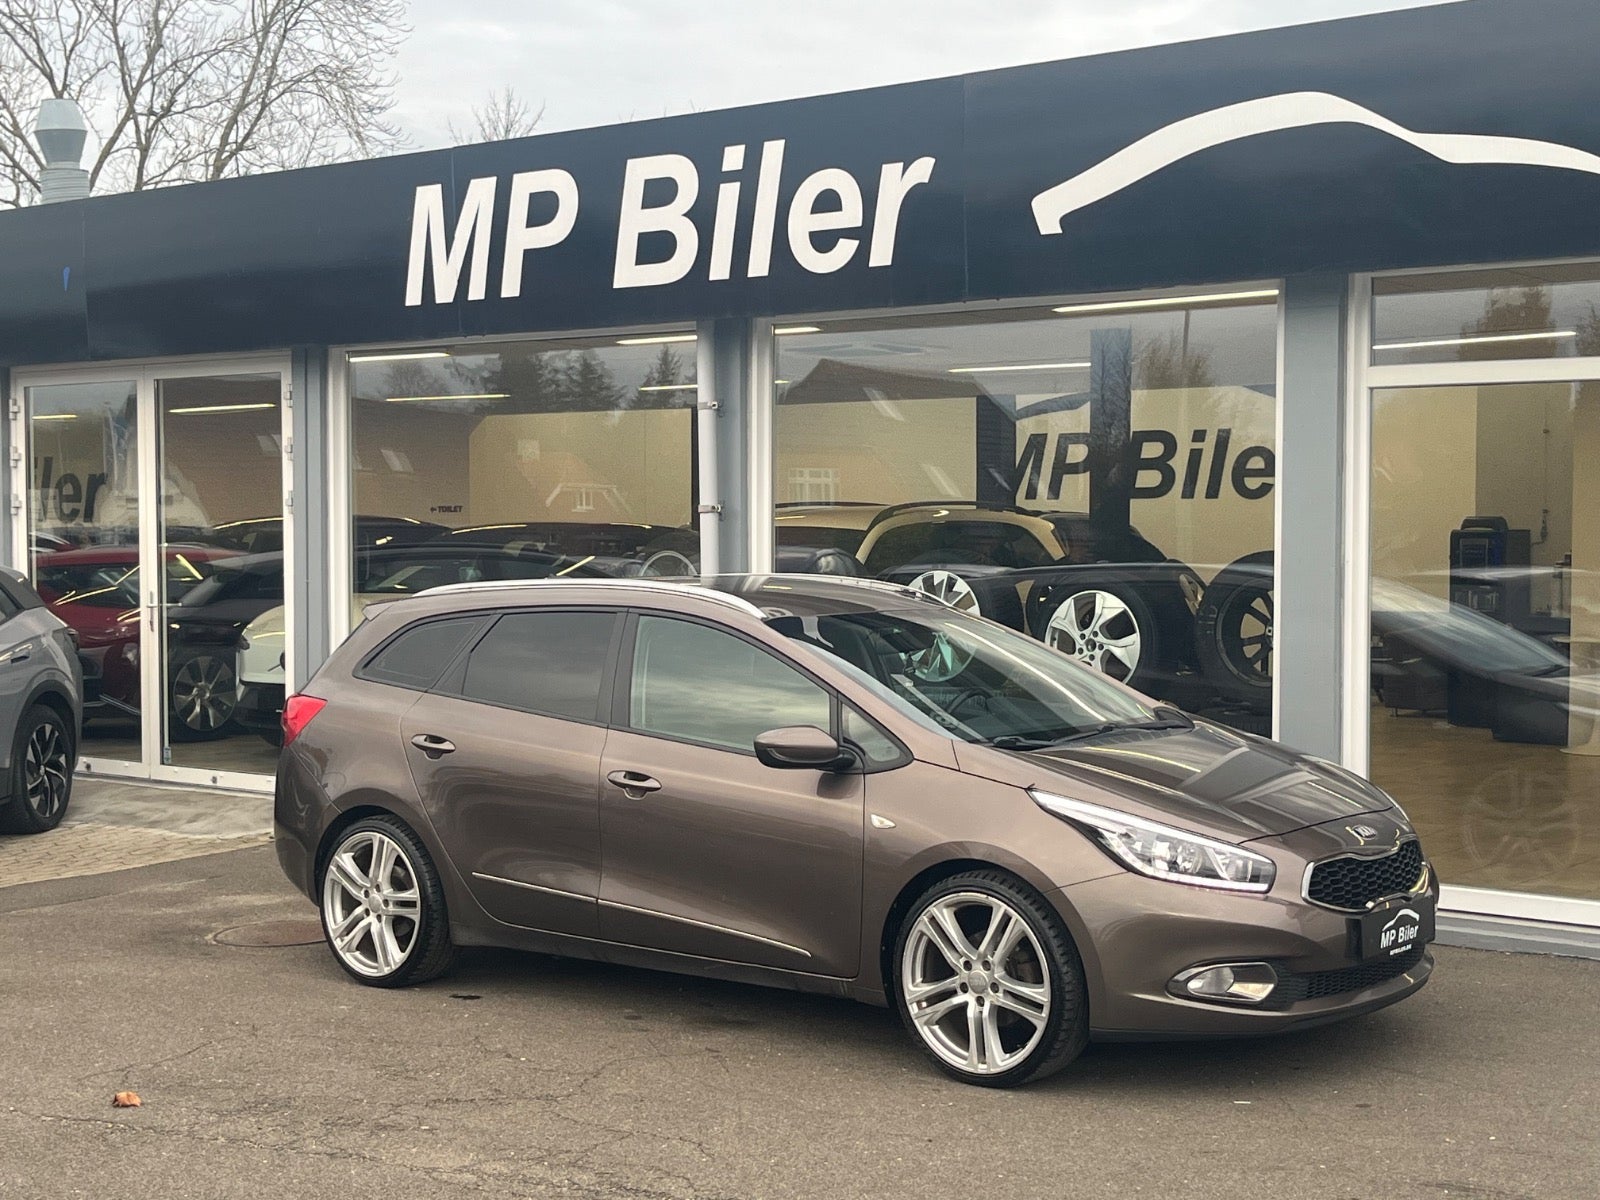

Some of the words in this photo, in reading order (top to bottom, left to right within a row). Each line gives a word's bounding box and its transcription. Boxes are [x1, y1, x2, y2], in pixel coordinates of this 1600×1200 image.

[405, 168, 579, 307] MP
[612, 138, 937, 289] Biler
[34, 456, 109, 524] ler
[438, 505, 464, 513] TOILET
[1381, 930, 1397, 950] MP
[1398, 924, 1419, 943] Biler
